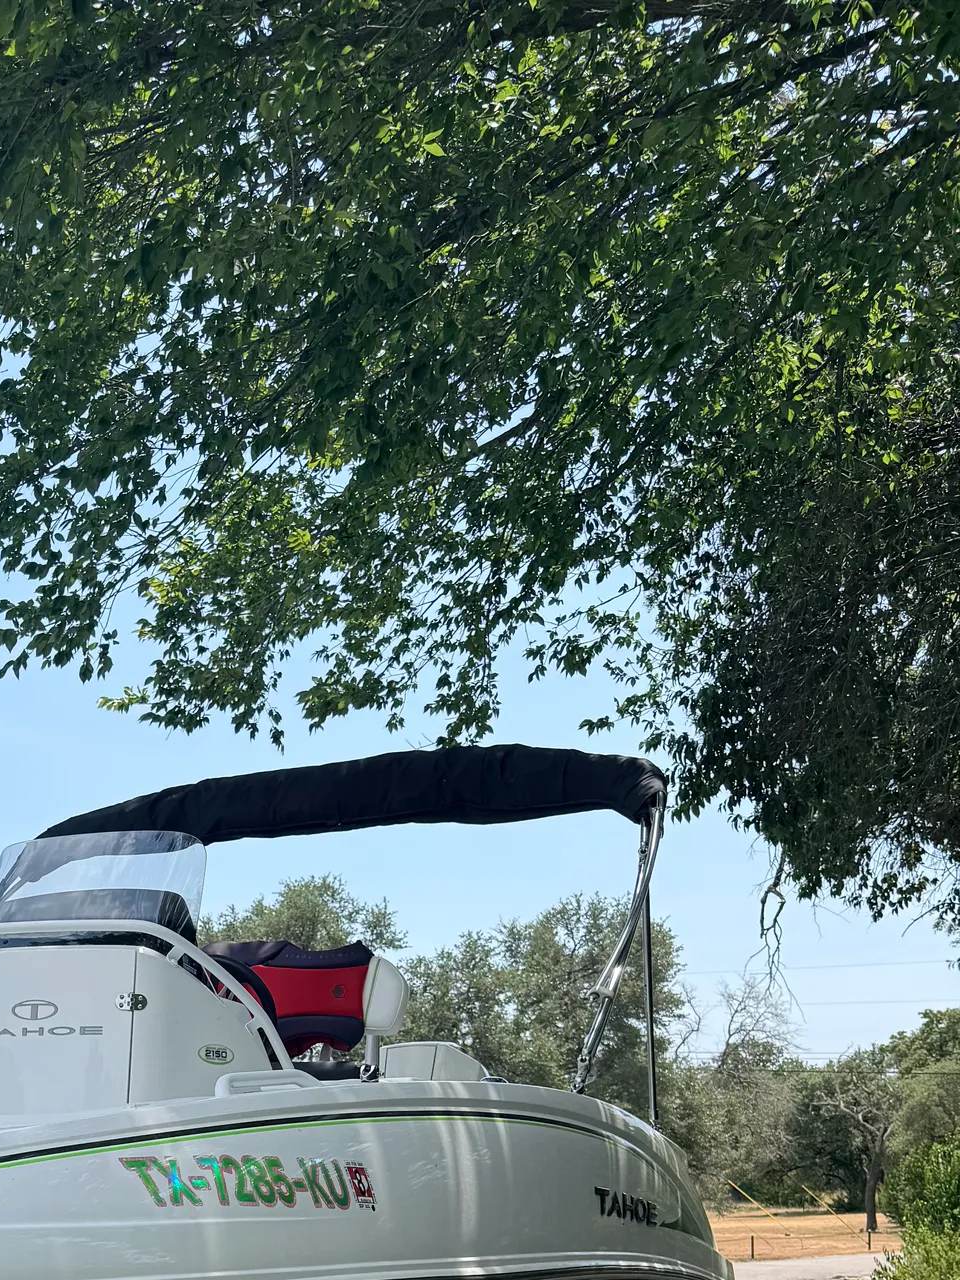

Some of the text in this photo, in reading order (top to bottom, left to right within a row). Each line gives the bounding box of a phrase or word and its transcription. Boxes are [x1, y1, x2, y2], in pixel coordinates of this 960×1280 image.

[205, 1049, 227, 1059] 2150
[118, 1155, 351, 1211] TX-7285-KU
[594, 1186, 658, 1227] TAHOE
